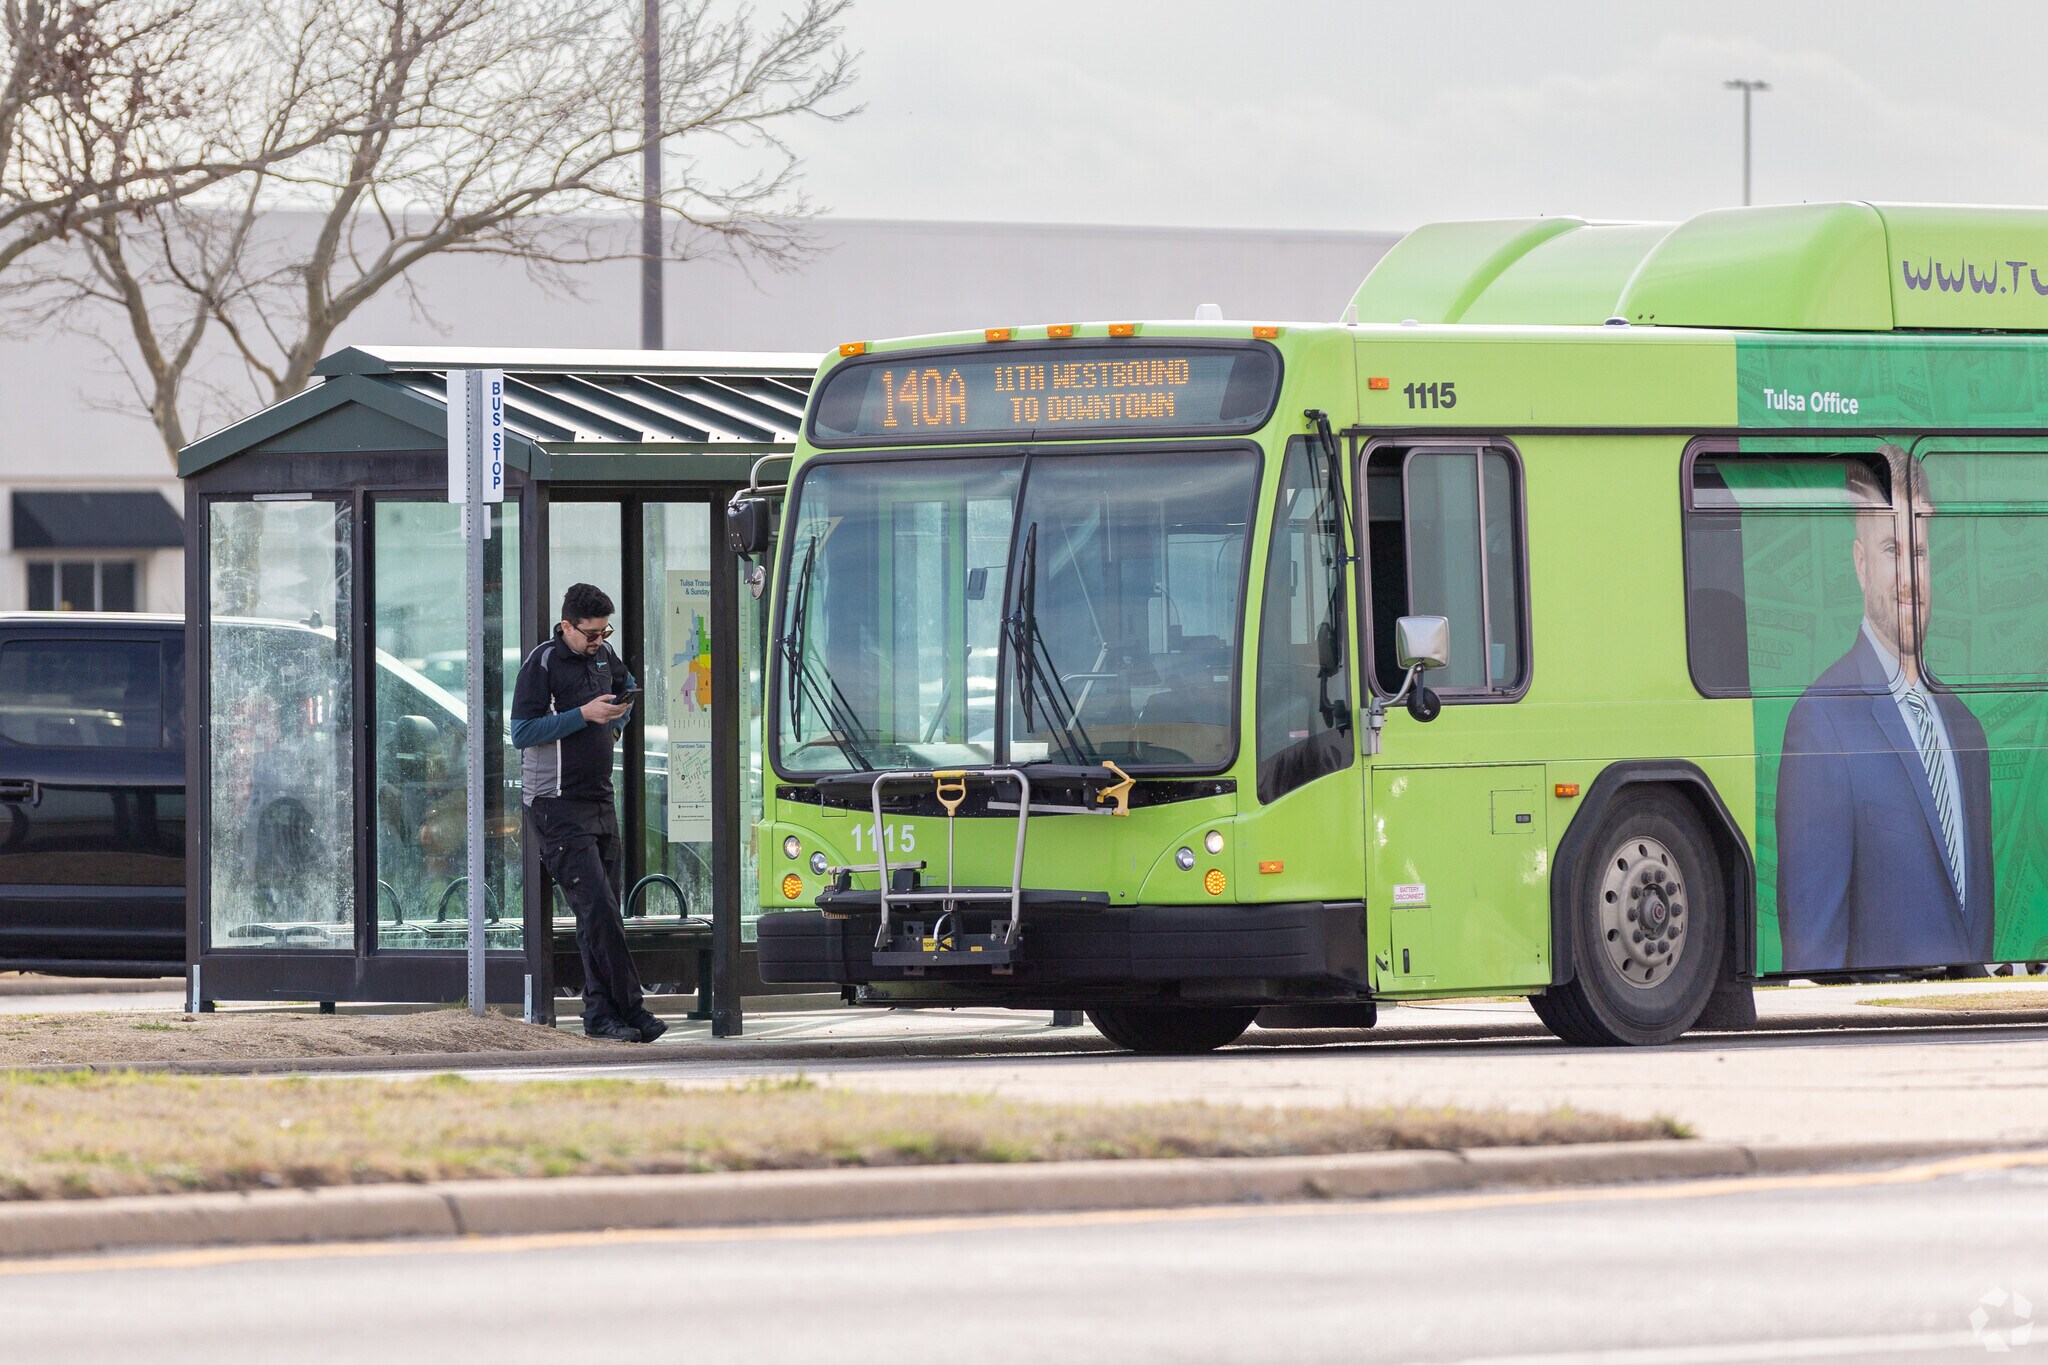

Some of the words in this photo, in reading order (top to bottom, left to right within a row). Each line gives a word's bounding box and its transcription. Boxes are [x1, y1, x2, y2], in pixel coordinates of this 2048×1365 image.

[994, 364, 1045, 392] 11TH
[1053, 359, 1190, 390] WESTBOUND
[492, 381, 501, 427] BUS
[882, 367, 966, 428] 140A
[1010, 396, 1040, 423] TO
[1047, 391, 1175, 422] DOWNTOWN
[1403, 382, 1457, 409] 1115
[1763, 388, 1806, 412] Tulsa
[1810, 391, 1859, 415] Office
[492, 432, 502, 490] STOP
[680, 579, 694, 587] Tulsa
[851, 823, 916, 853] 1115
